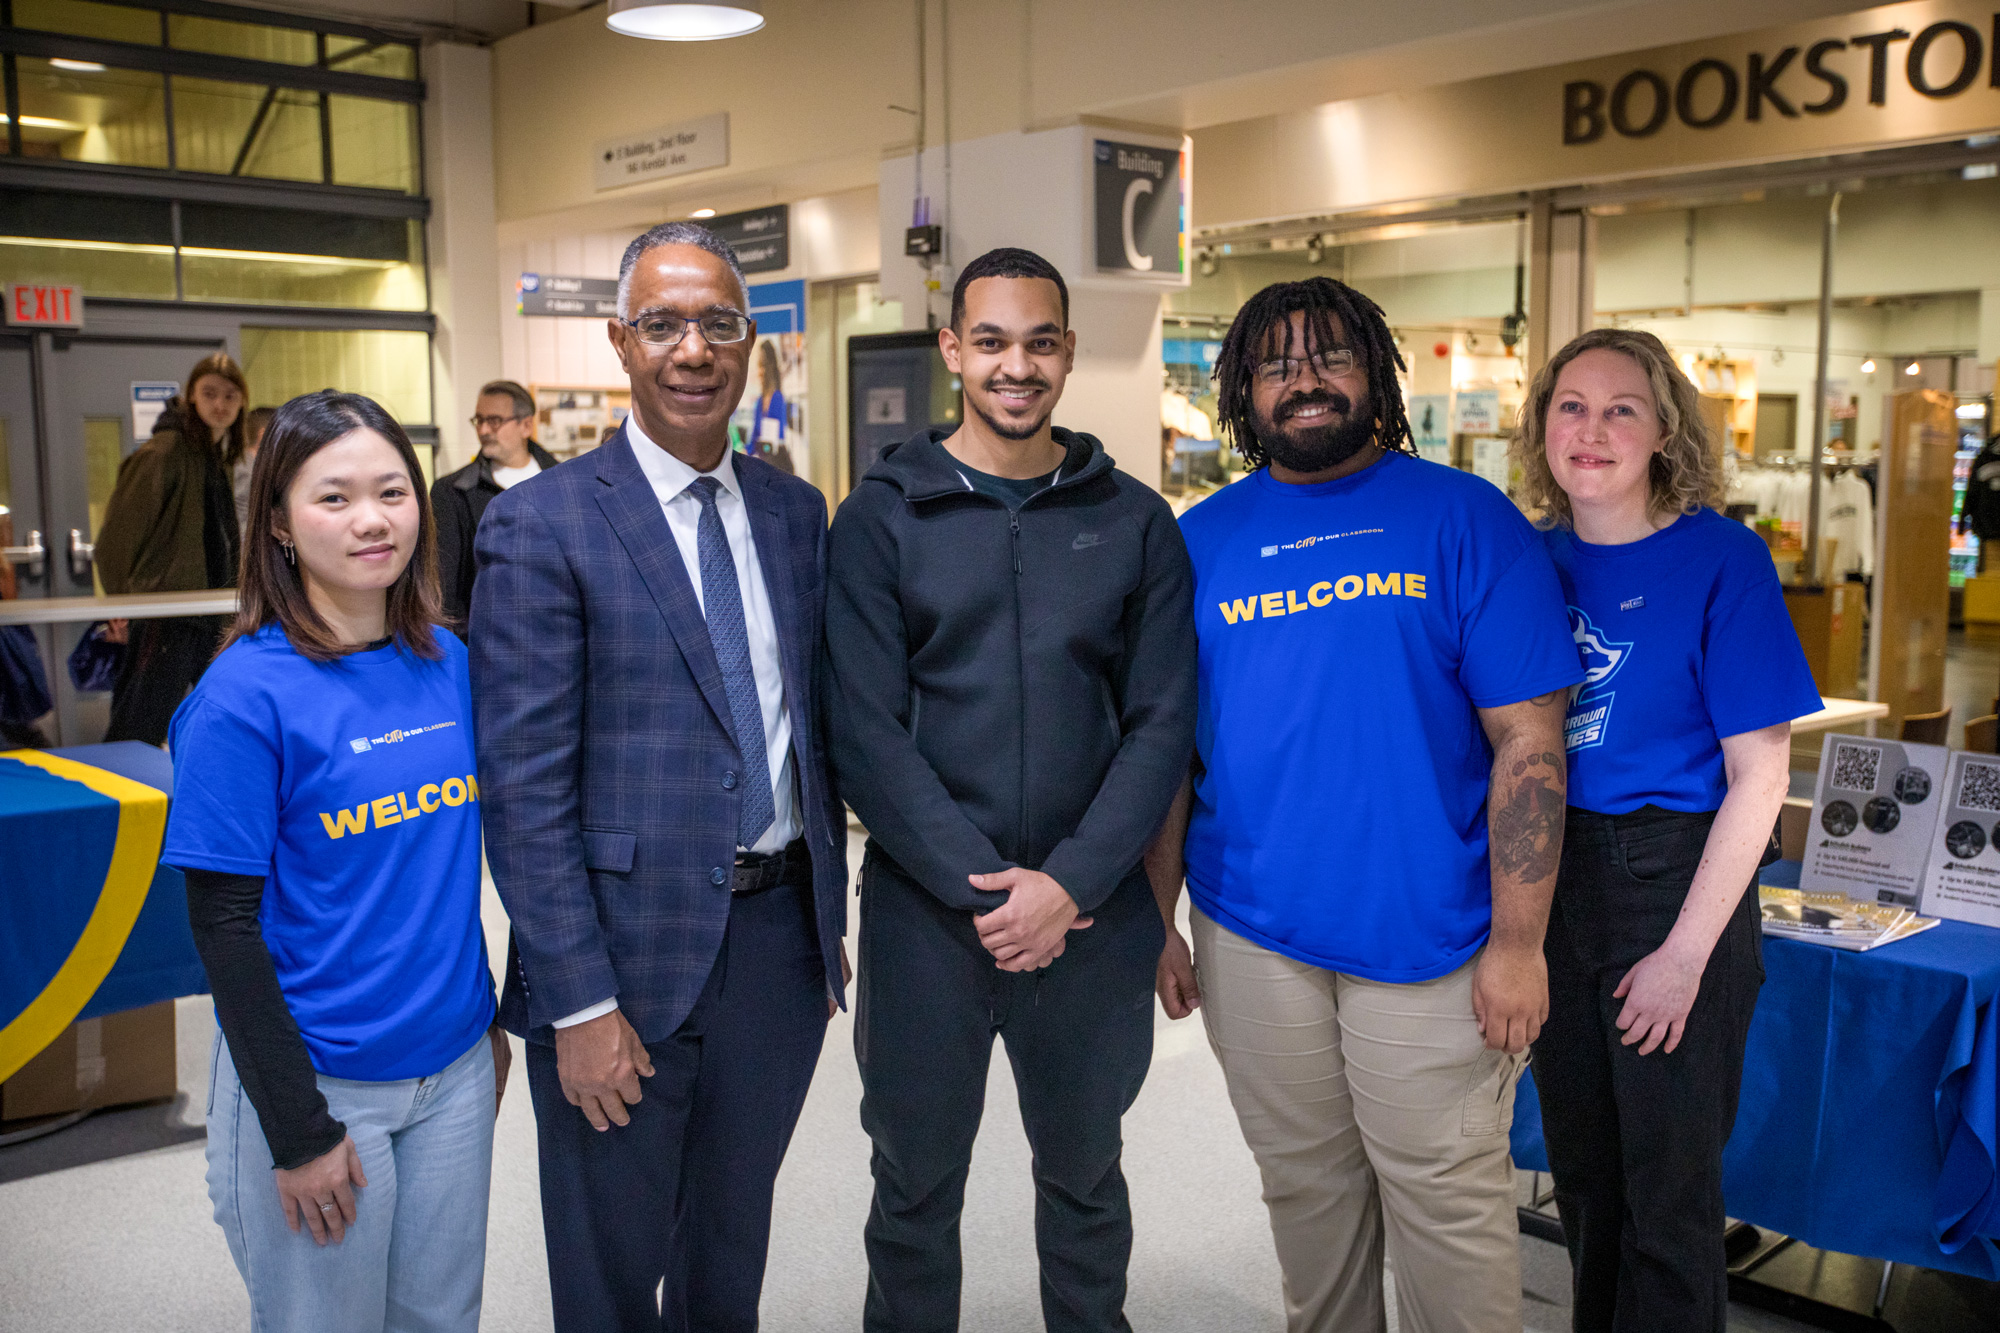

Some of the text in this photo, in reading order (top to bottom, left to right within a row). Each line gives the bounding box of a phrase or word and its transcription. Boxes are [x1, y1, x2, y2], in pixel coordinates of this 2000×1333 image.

[1117, 149, 1164, 179] Building
[1121, 178, 1153, 271] C
[15, 286, 72, 322] EXIT
[1295, 536, 1317, 549] CITY
[1340, 528, 1384, 538] CLASSROOM
[1218, 572, 1427, 625] WELCOME
[371, 737, 385, 745] THE
[384, 729, 404, 744] CITY
[410, 727, 424, 736] OUR
[423, 720, 456, 732] CLASSROOM
[1564, 724, 1602, 750] IES
